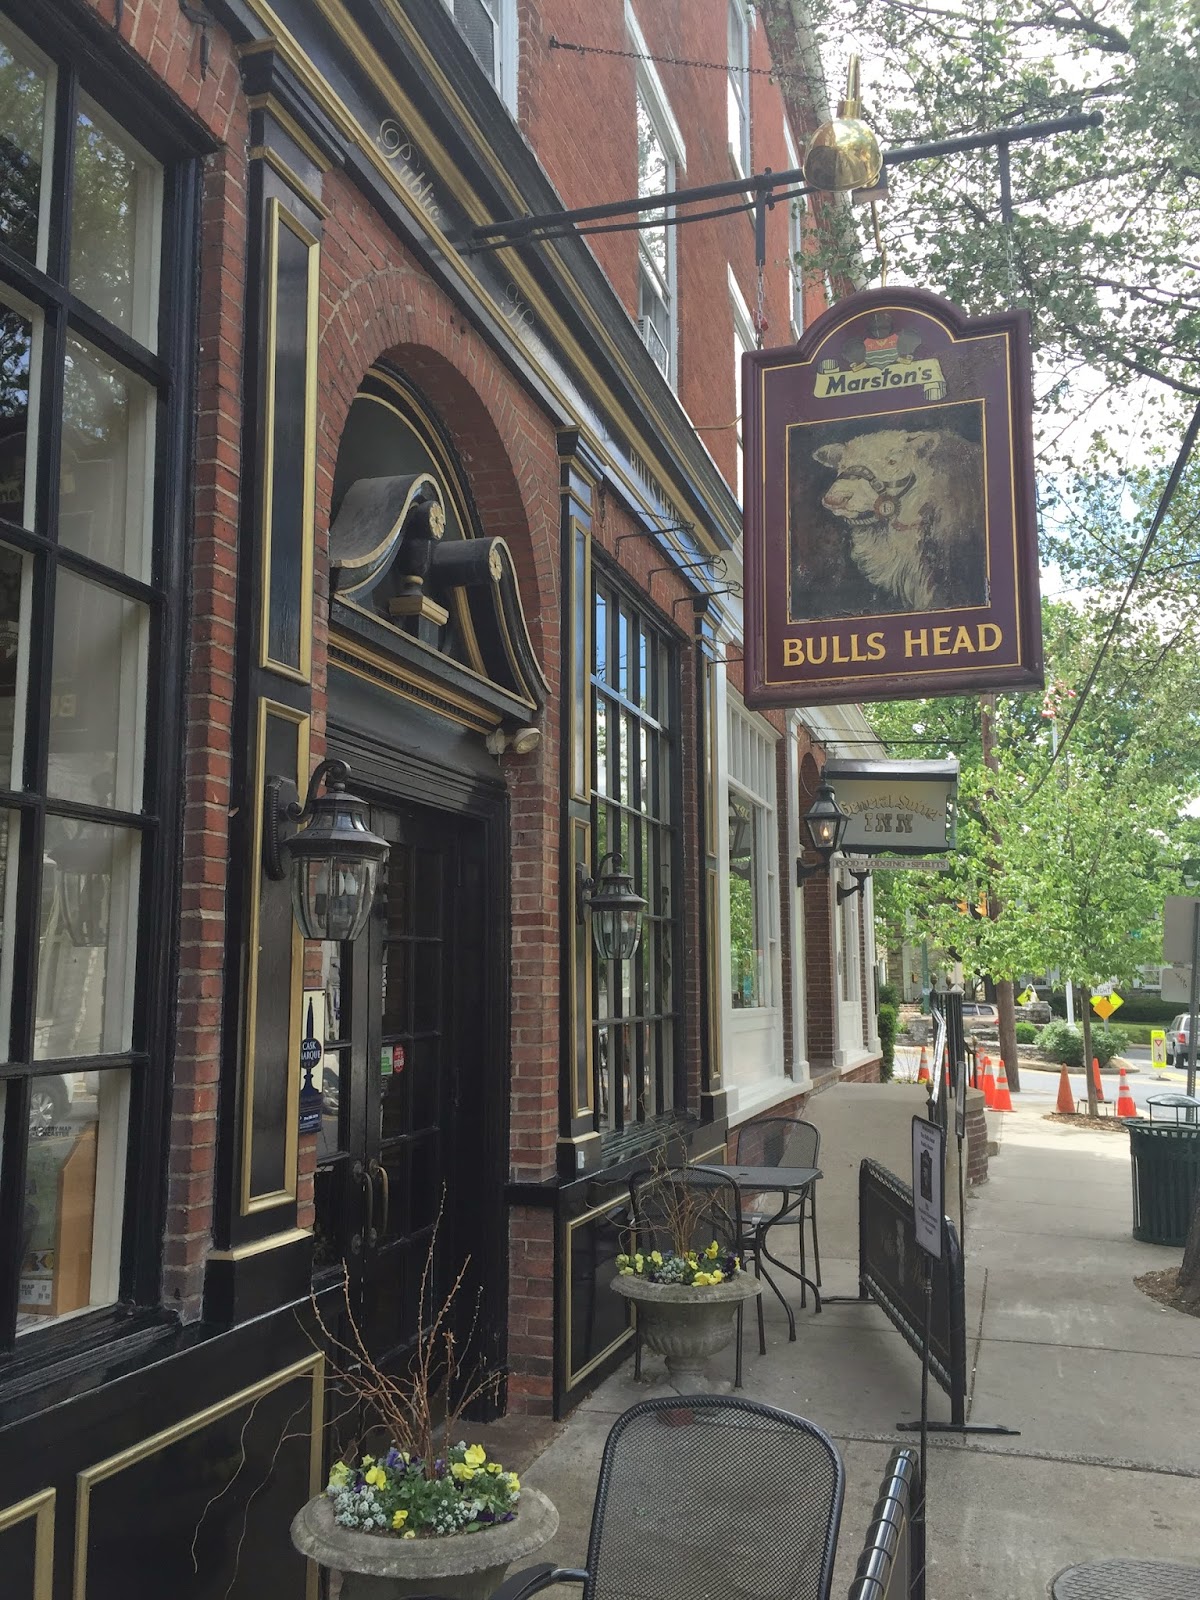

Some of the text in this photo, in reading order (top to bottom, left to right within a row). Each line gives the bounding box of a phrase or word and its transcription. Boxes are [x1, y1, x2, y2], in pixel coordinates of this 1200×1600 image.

[377, 118, 440, 221] Public
[825, 366, 933, 396] Marston's
[630, 447, 657, 502] BULLS
[783, 623, 1003, 667] BULLS HEAD
[839, 795, 894, 816] General
[864, 813, 913, 833] INN
[836, 860, 946, 869] FOOD LODGING SPIRITS
[302, 1041, 317, 1051] CASK
